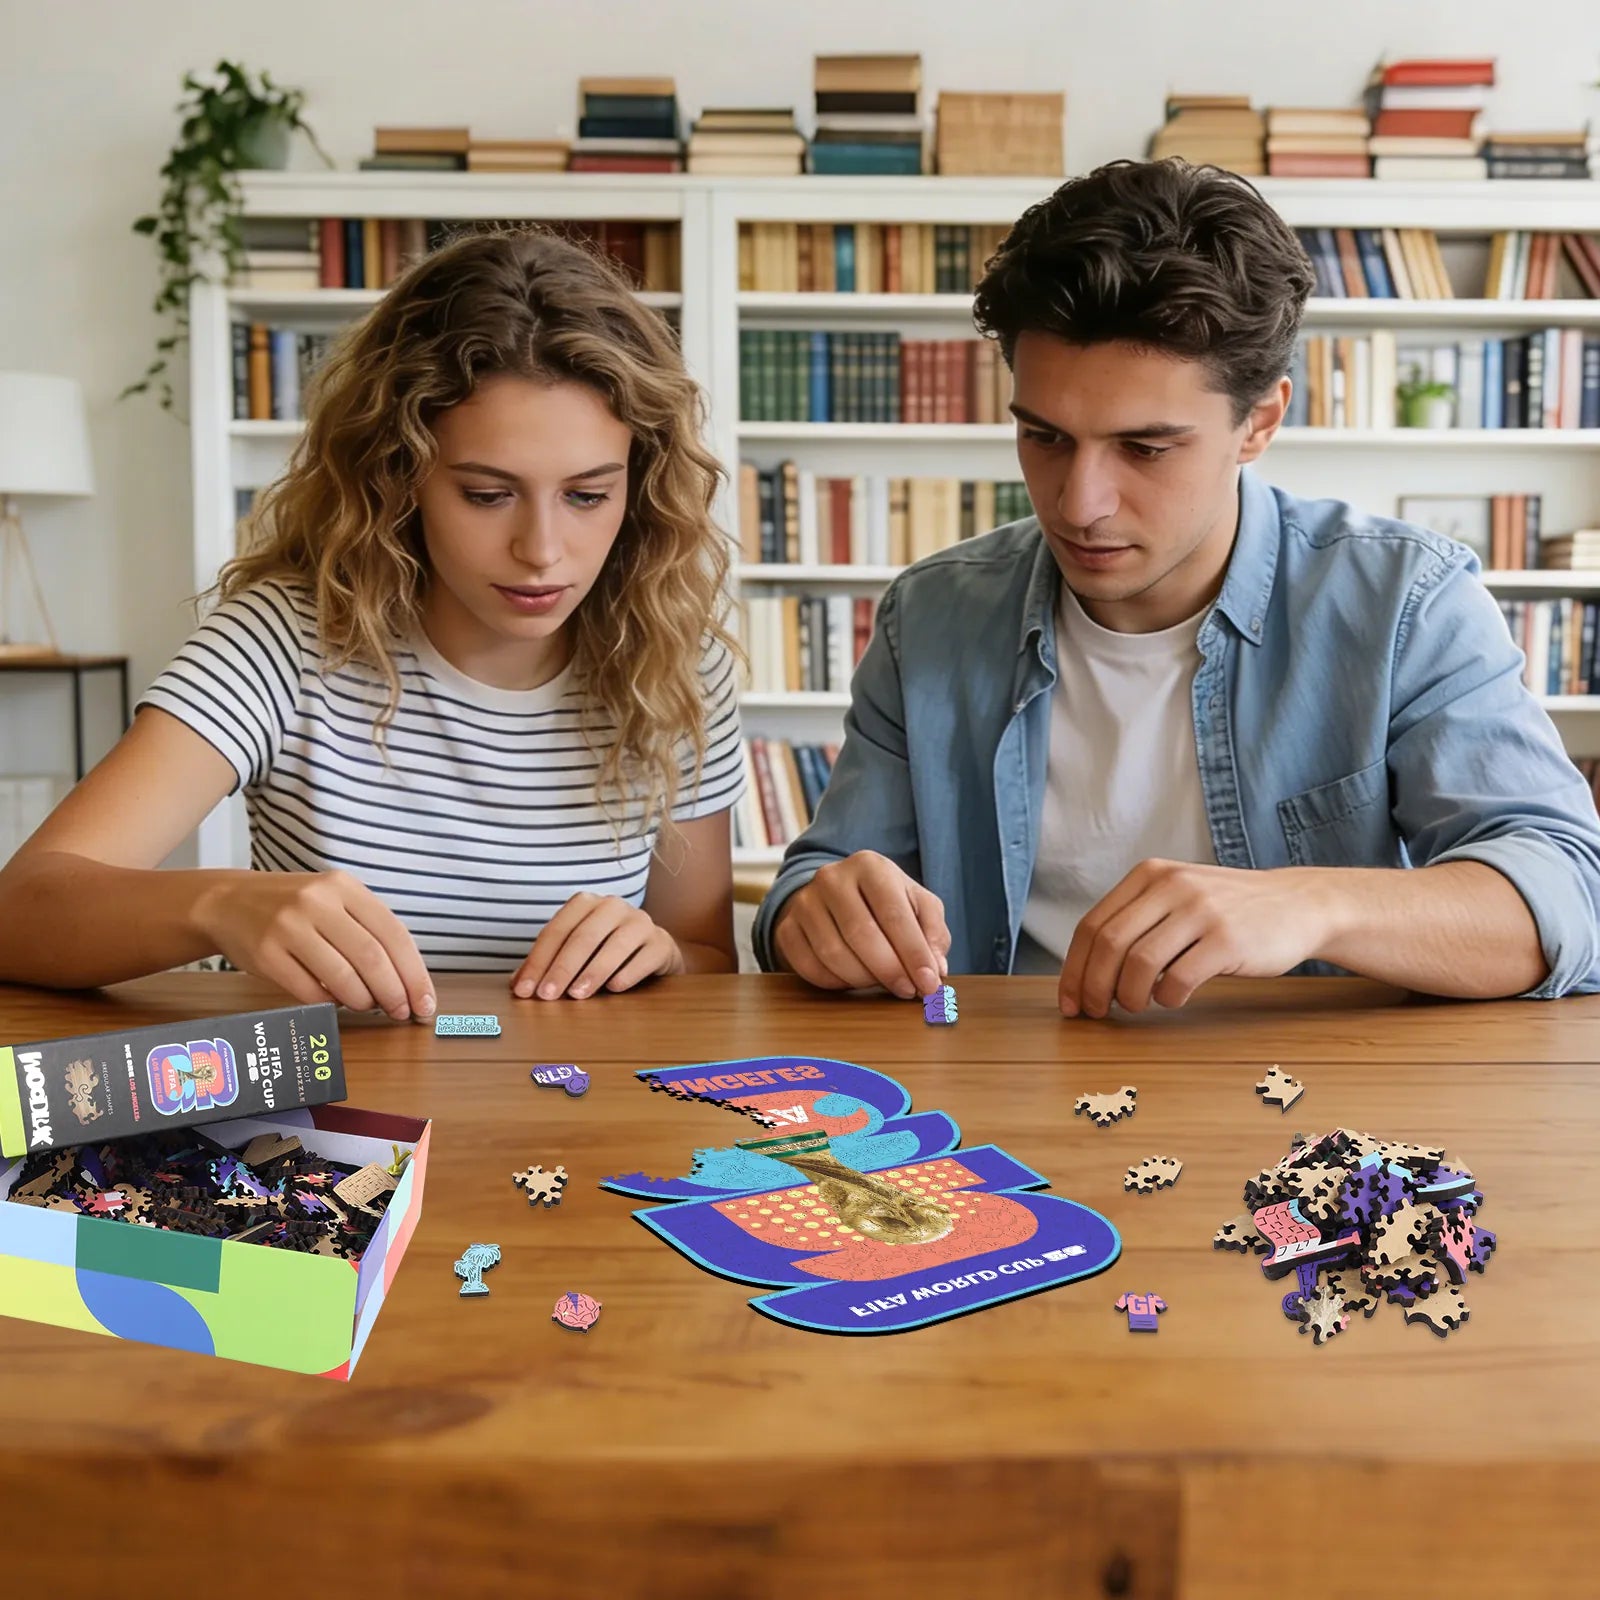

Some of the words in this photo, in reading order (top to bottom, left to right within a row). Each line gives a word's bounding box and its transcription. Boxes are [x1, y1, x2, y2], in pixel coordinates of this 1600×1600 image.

[269, 1046, 283, 1080] FIFA
[289, 1018, 300, 1063] WOODEN
[295, 1065, 306, 1103] PUZZLE
[299, 1035, 308, 1061] LASER
[309, 1033, 332, 1081] 200
[101, 1061, 111, 1093] IRREGULAR
[167, 1068, 177, 1090] FIFA
[253, 1021, 271, 1077] WORLD
[262, 1078, 275, 1109] CUP
[303, 1065, 311, 1083] CUT
[105, 1093, 114, 1116] SHAPES
